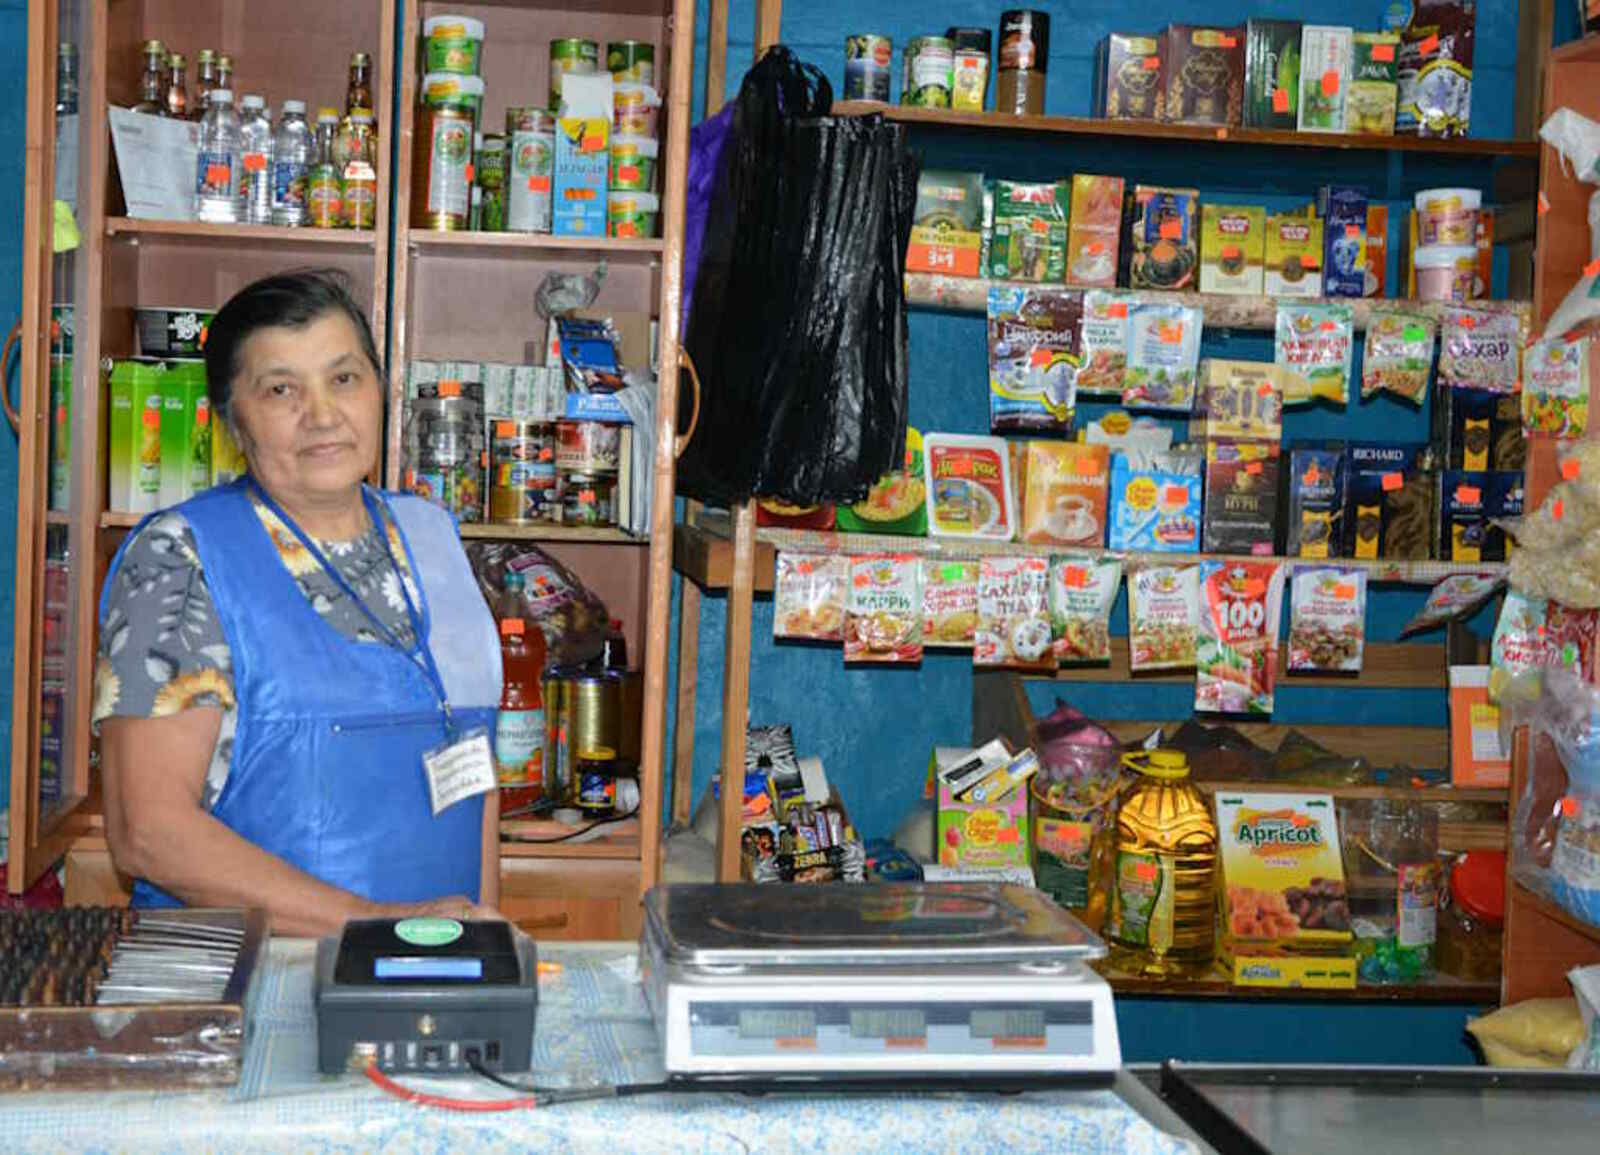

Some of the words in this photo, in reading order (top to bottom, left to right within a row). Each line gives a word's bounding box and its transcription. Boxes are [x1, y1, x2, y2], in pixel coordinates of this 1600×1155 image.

[1353, 448, 1404, 460] RICHARD
[1220, 599, 1264, 630] 100
[1238, 824, 1320, 846] Apricot
[794, 851, 827, 868] ZEBRA
